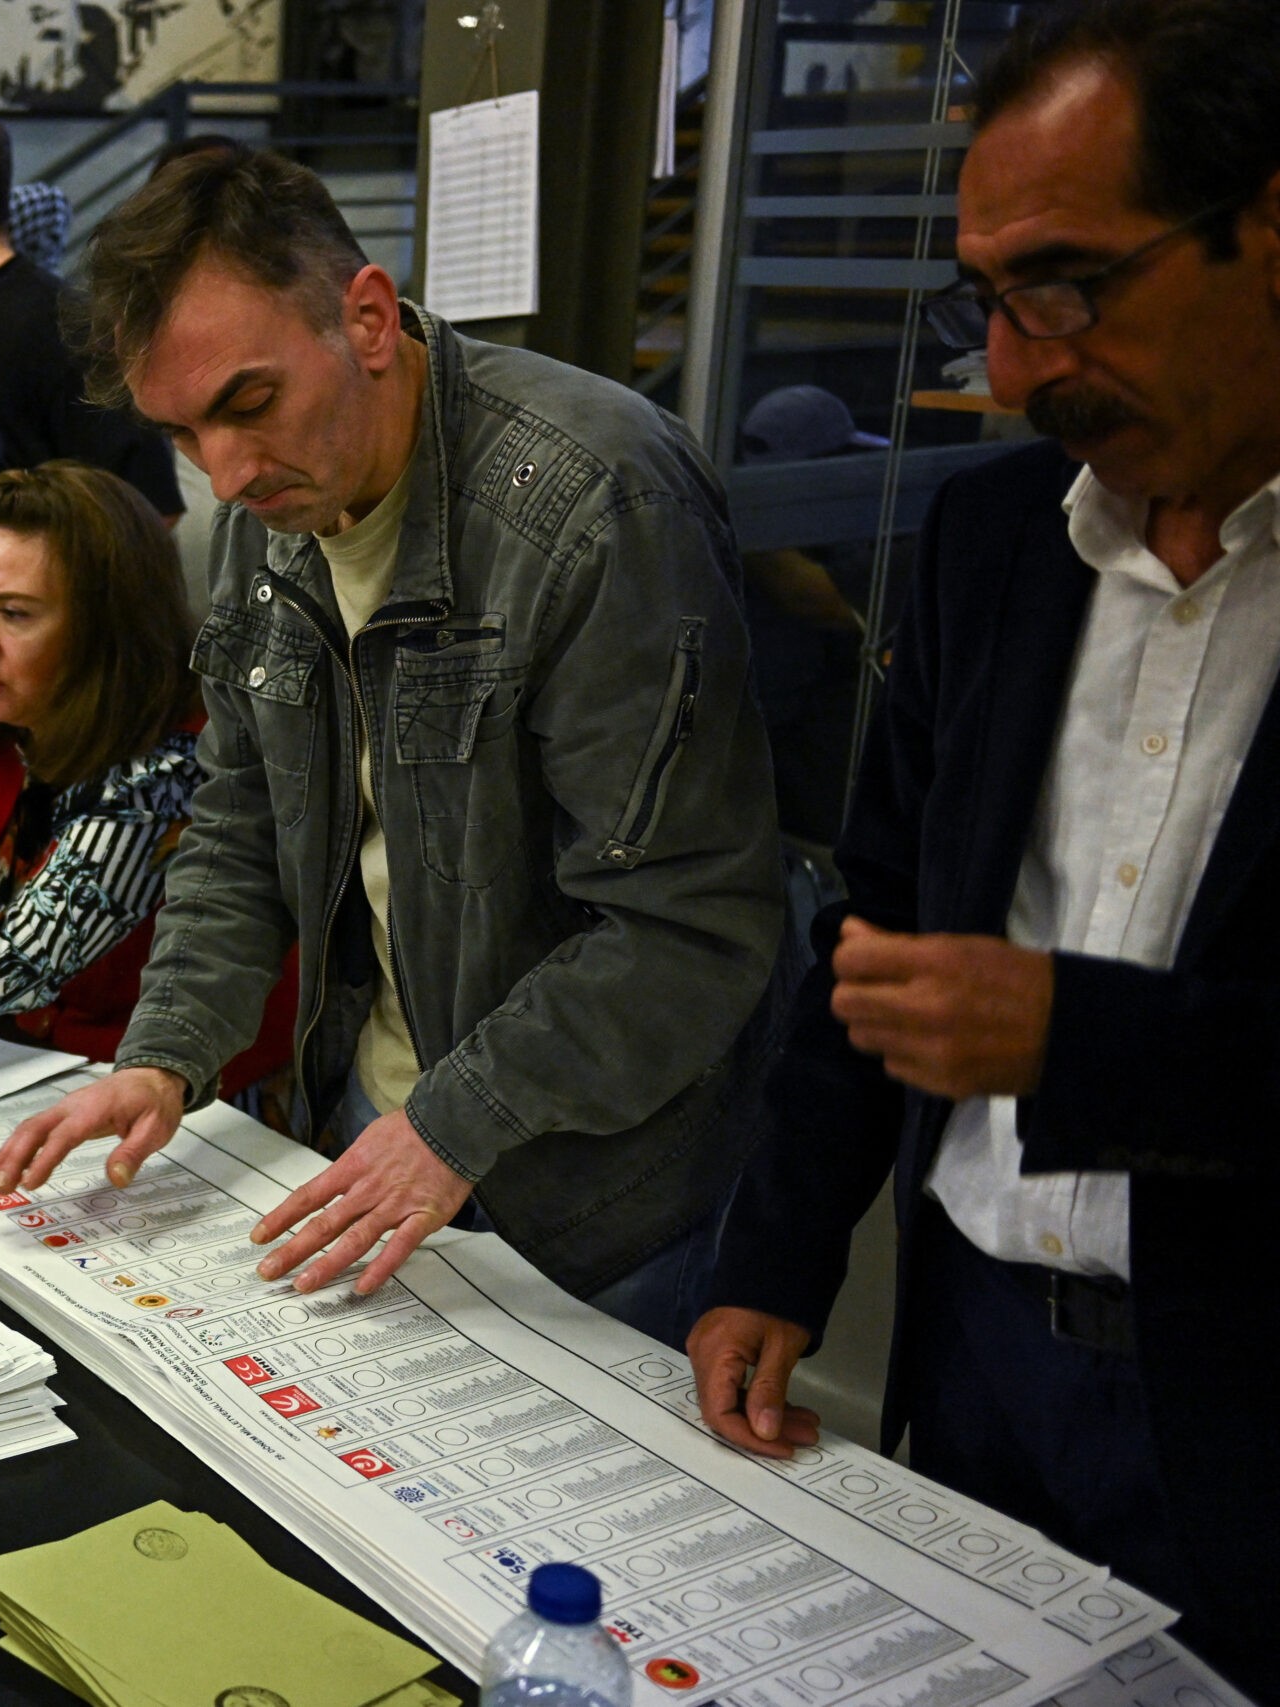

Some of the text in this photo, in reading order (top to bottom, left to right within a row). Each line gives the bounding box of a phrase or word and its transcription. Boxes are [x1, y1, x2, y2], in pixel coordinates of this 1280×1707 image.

[61, 1230, 83, 1243] HKP
[21, 1264, 48, 1282] PUSULASI
[152, 1348, 174, 1365] SİYASİ
[161, 1345, 175, 1354] (2)
[170, 1364, 195, 1383] SEÇİMİ
[177, 1360, 208, 1386] İSTANBUL
[251, 1355, 278, 1376] MHP
[189, 1382, 213, 1401] GENEL
[208, 1401, 252, 1436] MİLLETVEKİLİ
[248, 1435, 275, 1453] DÖNEM
[369, 1447, 387, 1458] BİRLİK
[383, 1457, 401, 1468] BÜYÜK
[611, 1618, 647, 1639] TKP
